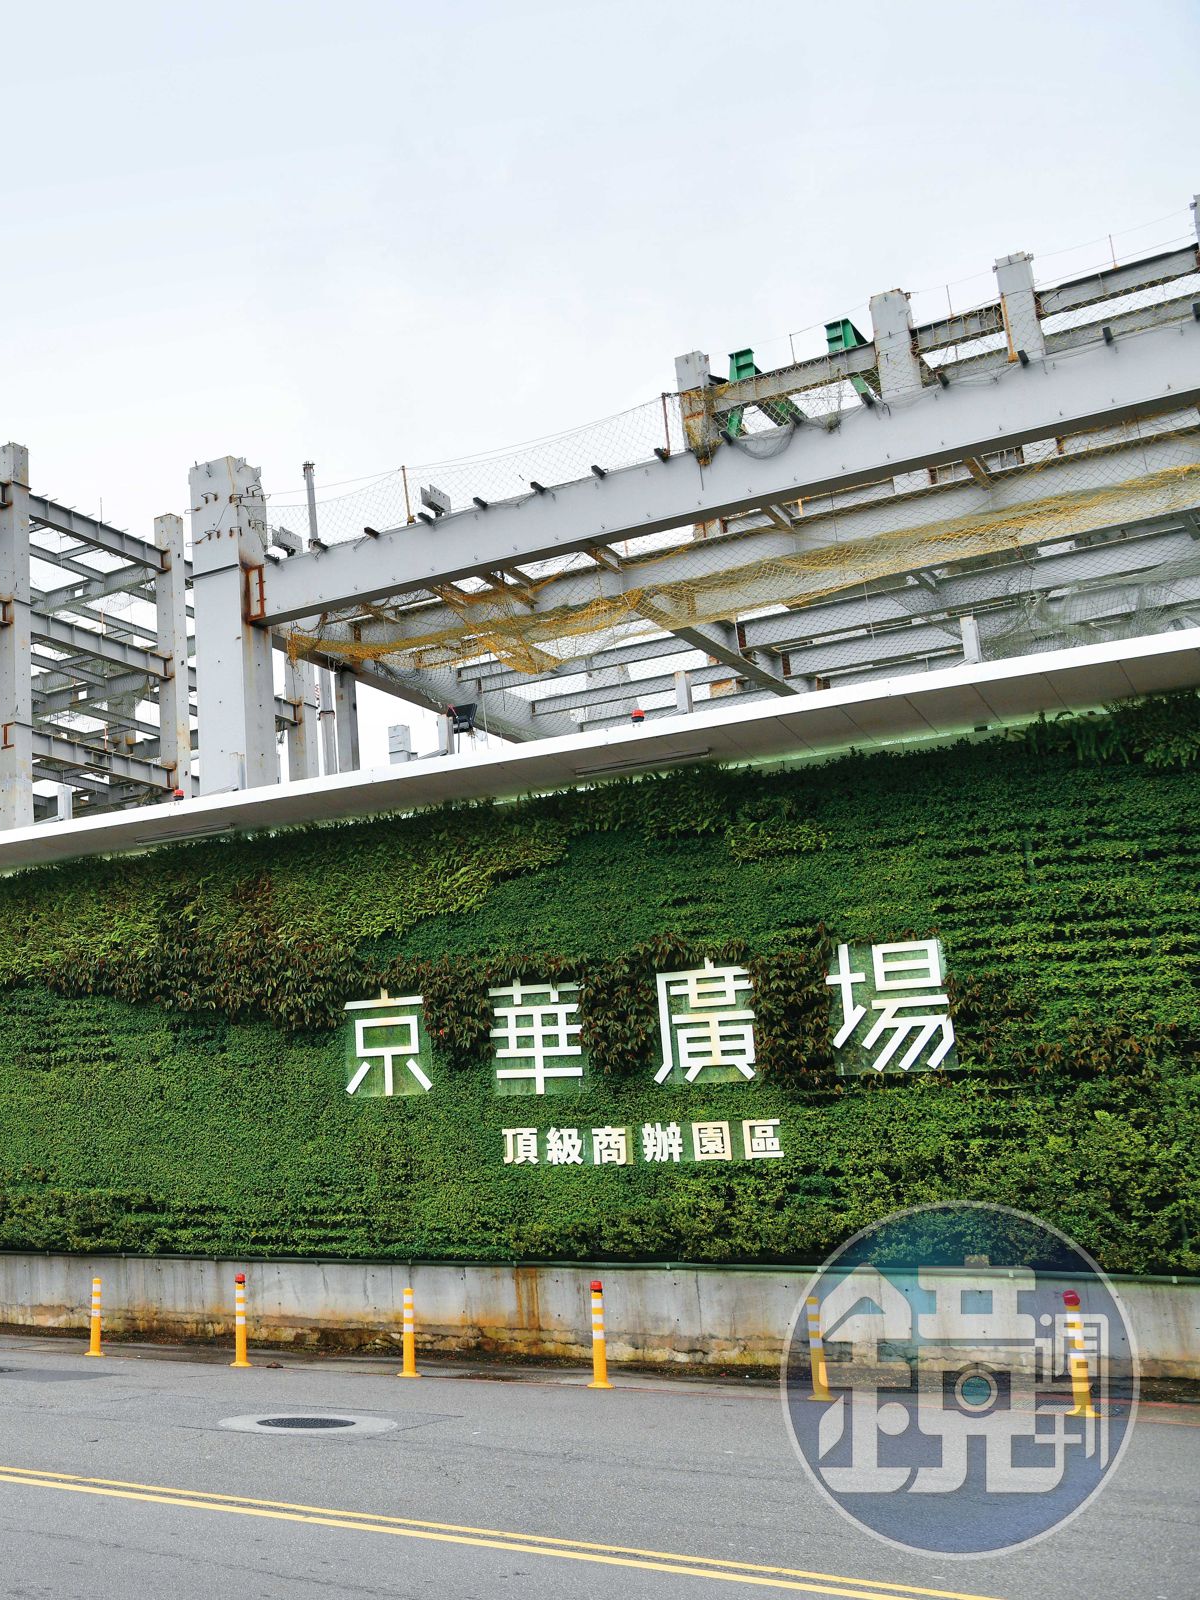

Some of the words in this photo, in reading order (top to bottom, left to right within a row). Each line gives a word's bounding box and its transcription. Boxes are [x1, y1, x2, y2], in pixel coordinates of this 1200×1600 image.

[344, 938, 955, 1097] 京華廣場
[502, 1118, 785, 1167] 頂級商辦園區
